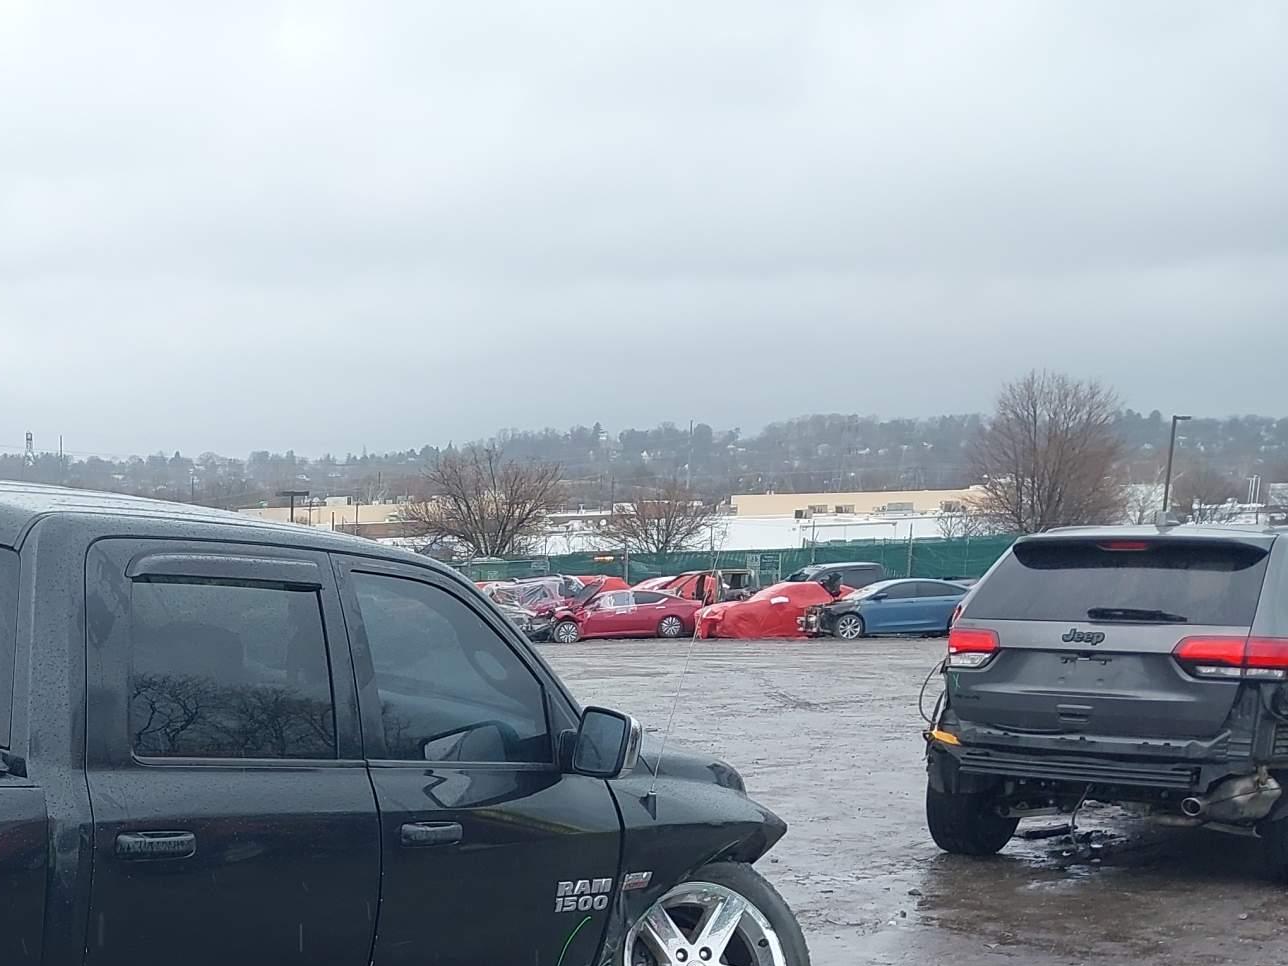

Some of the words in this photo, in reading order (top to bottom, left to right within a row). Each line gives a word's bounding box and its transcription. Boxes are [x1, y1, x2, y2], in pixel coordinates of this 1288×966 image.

[1062, 628, 1105, 646] Jeep
[556, 878, 613, 897] RAM
[554, 895, 609, 913] 1500
